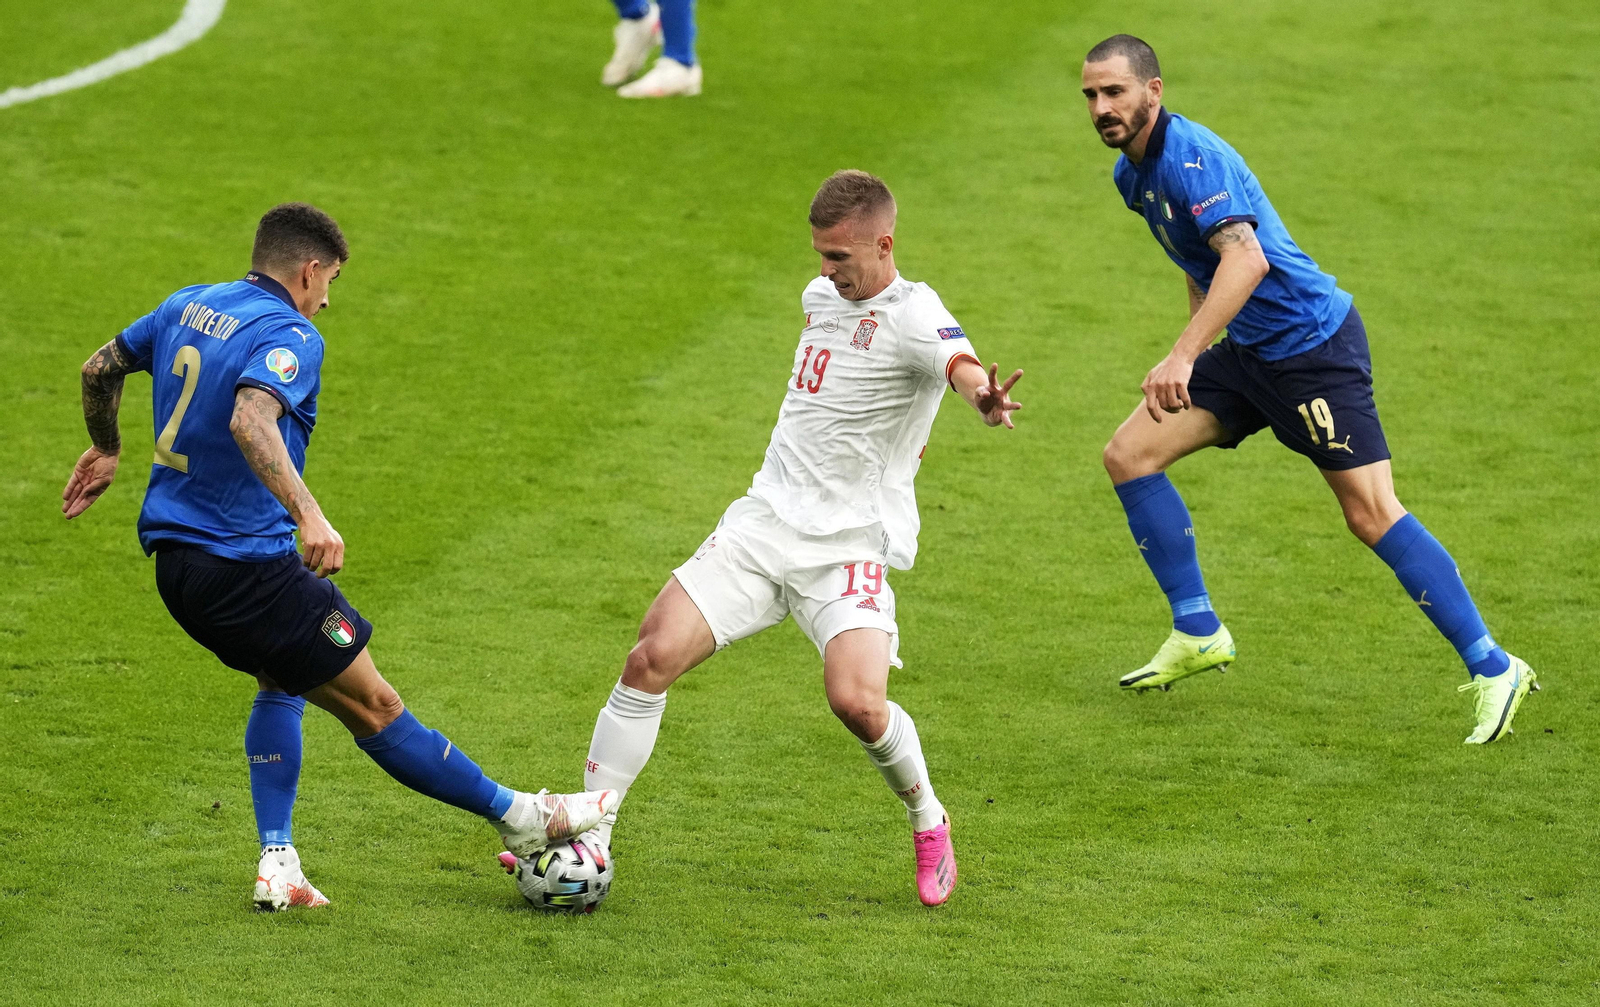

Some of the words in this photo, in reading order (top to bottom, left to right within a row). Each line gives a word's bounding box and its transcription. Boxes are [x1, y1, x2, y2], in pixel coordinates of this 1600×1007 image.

[1201, 191, 1229, 209] RESPECT
[796, 345, 831, 394] 19
[153, 345, 201, 473] 2
[1298, 398, 1335, 445] 19
[841, 562, 882, 596] 19
[324, 613, 340, 632] ITALIA
[856, 603, 881, 613] adidas
